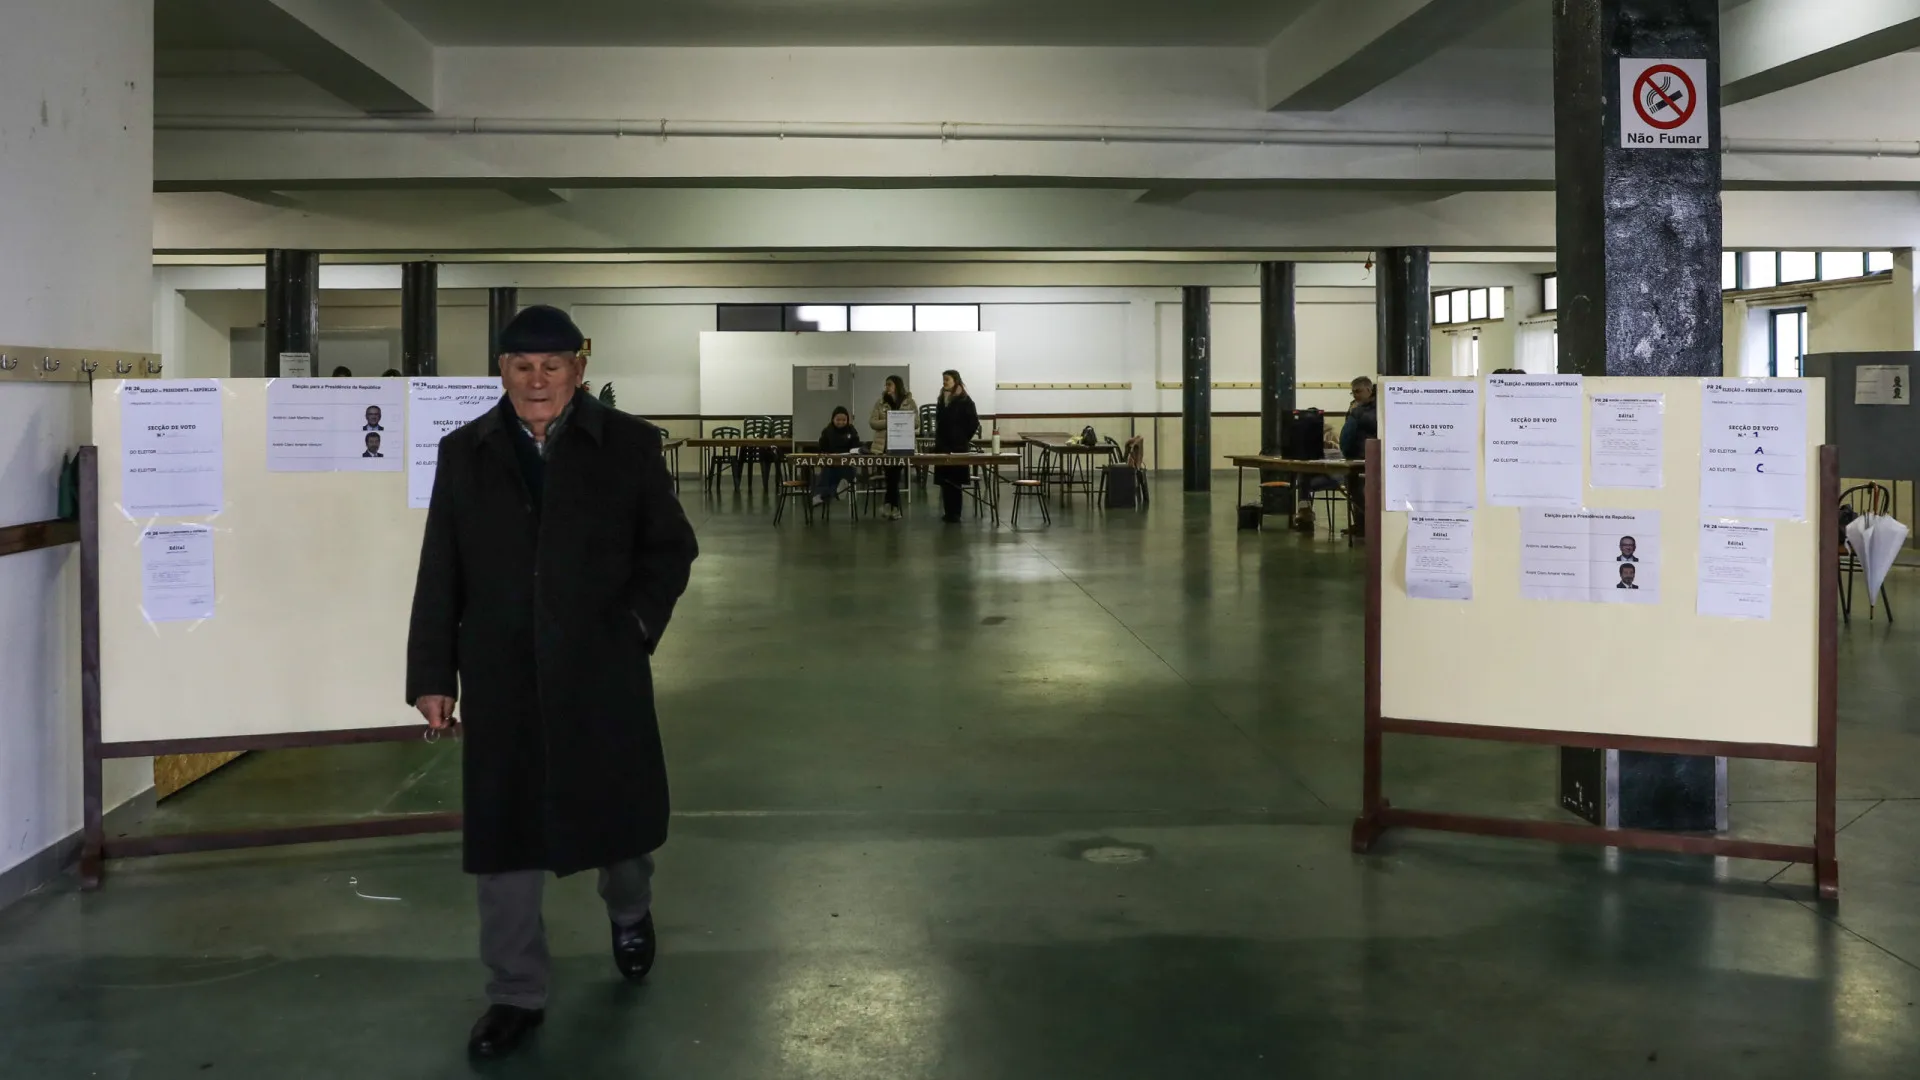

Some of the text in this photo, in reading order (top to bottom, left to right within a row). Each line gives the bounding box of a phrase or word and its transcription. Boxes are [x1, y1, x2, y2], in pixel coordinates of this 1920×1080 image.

[1627, 132, 1702, 144] Não Fumar
[796, 457, 833, 466] SALÃO
[1756, 463, 1764, 473] C
